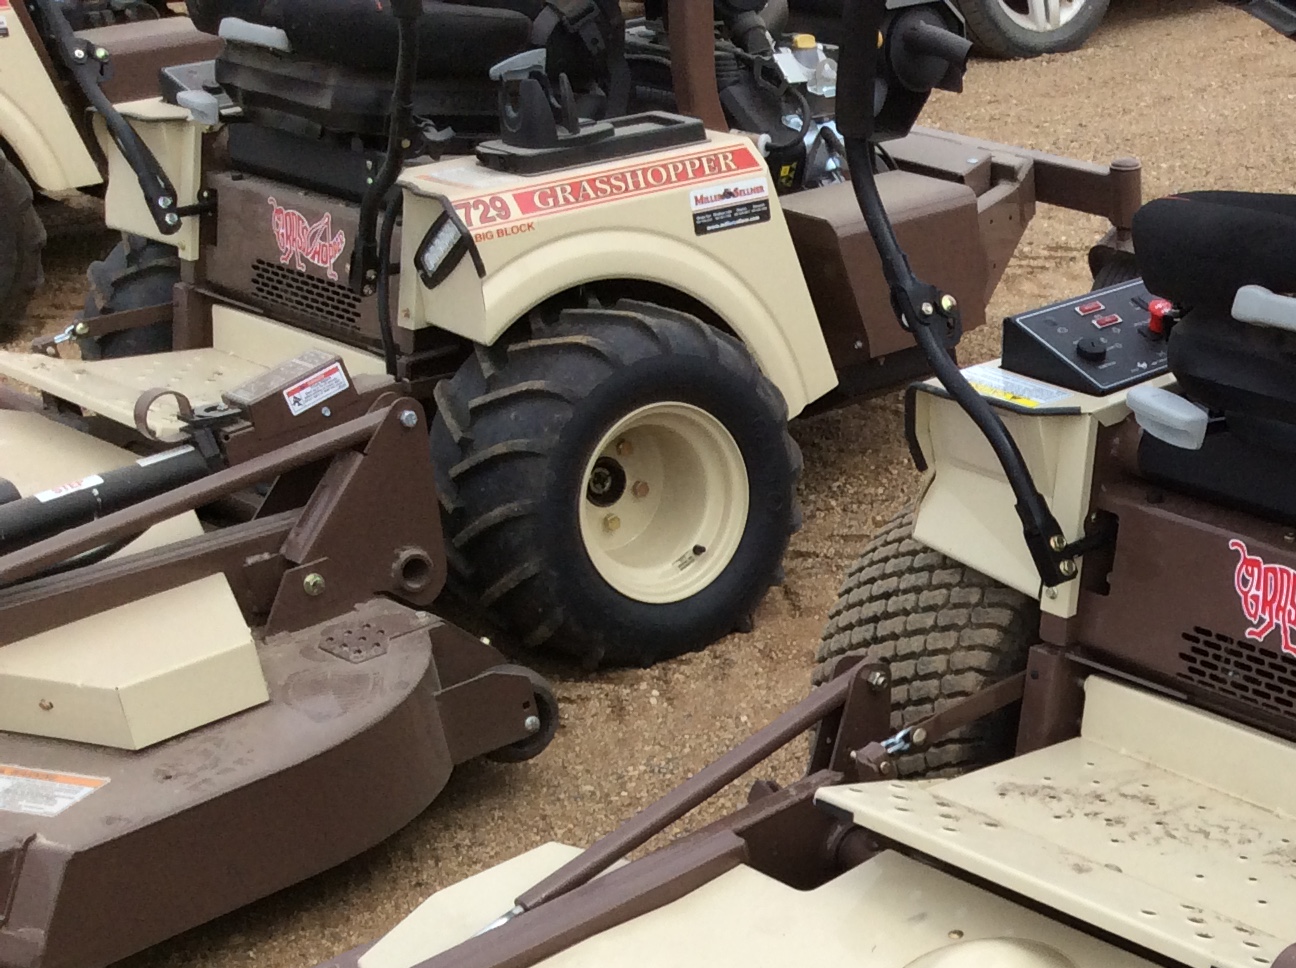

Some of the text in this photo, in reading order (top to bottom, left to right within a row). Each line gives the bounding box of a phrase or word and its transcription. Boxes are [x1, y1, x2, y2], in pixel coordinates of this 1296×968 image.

[455, 151, 738, 227] 729 GRASSHOPPER
[474, 222, 535, 243] BIG BLOCK
